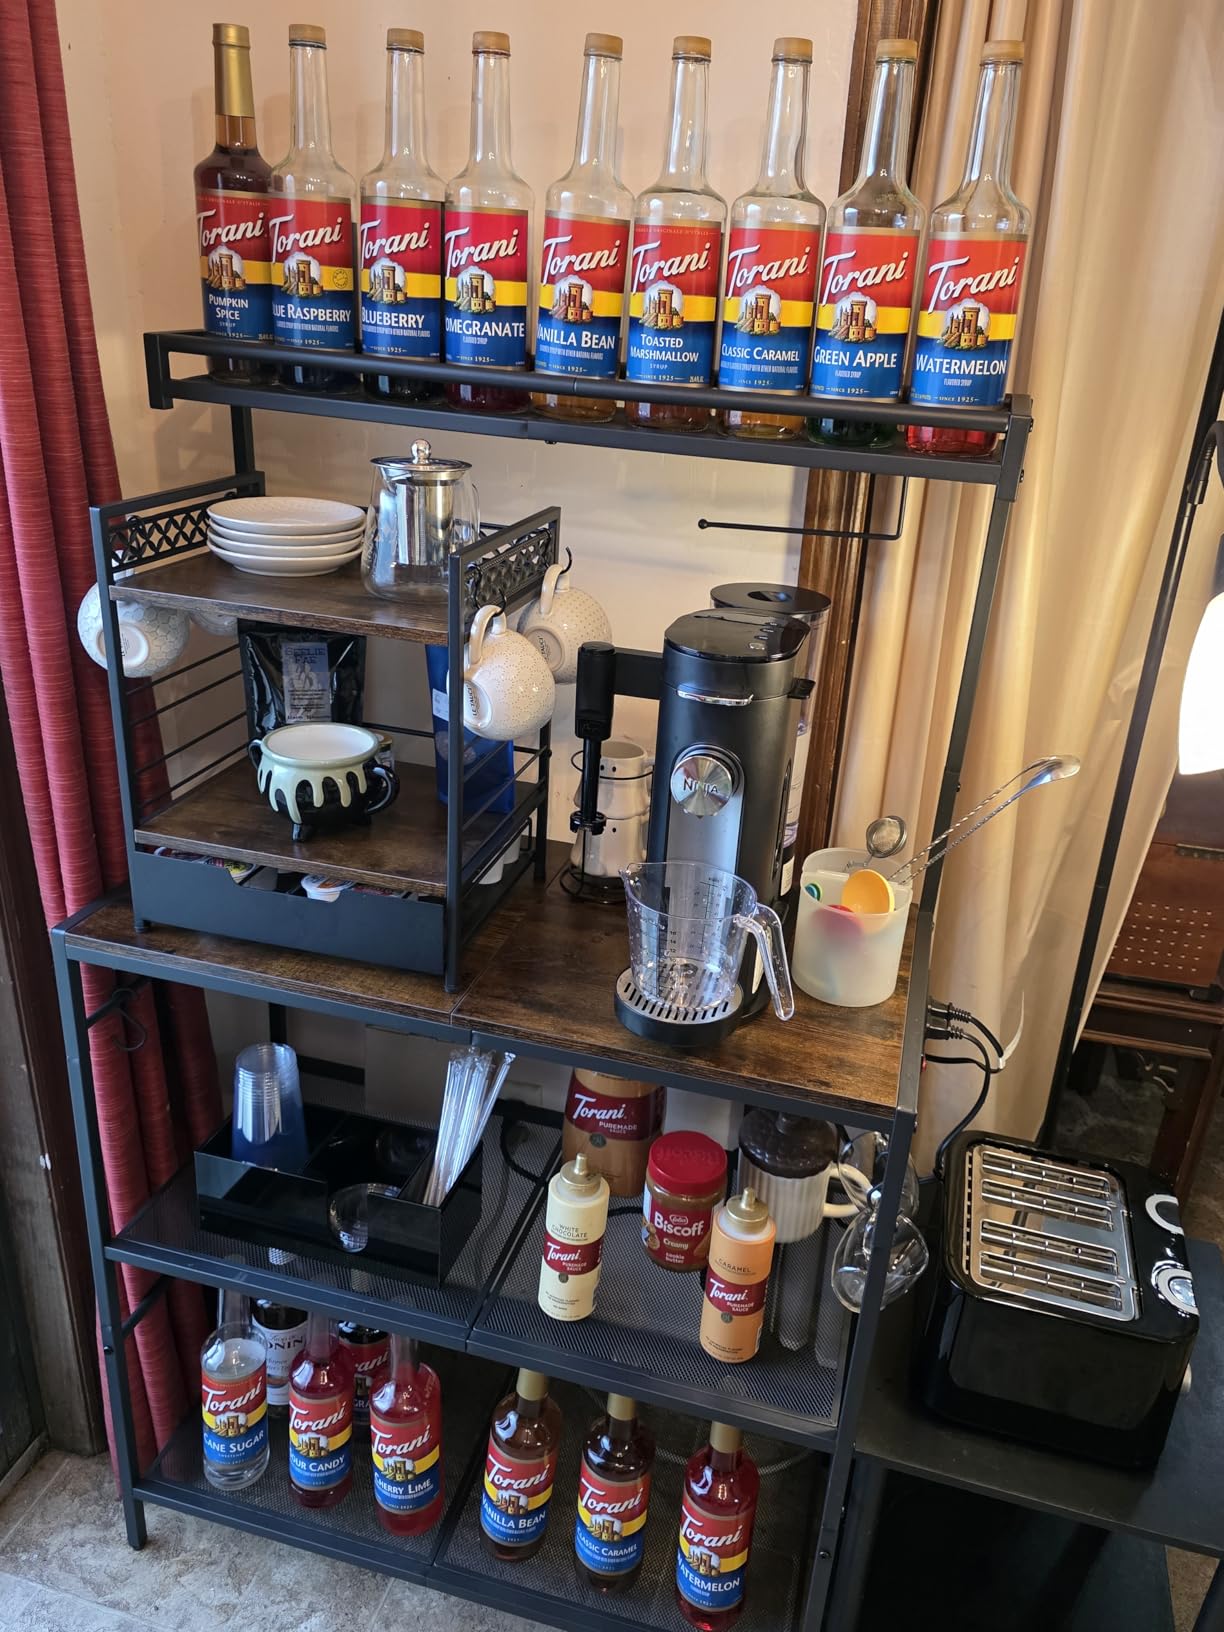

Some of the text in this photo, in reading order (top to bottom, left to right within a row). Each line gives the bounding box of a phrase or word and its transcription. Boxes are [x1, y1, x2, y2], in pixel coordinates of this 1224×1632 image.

[197, 208, 264, 247] Torani
[269, 213, 342, 264] Torani
[360, 219, 429, 269] Torani
[445, 227, 518, 280] Torani
[543, 235, 620, 287] Torani
[633, 240, 710, 295] Torani
[727, 244, 810, 300] Torani
[823, 249, 908, 306] Torani
[928, 256, 1019, 315] Torani
[208, 293, 249, 309] PUMPKIN
[287, 303, 351, 322] RASPBERRY
[215, 307, 240, 320] SPICE
[361, 306, 425, 329] BLUEBERRY
[446, 317, 525, 337] OMEGRANATE
[581, 331, 616, 349] BEAN
[641, 333, 684, 348] TOASTED
[630, 345, 699, 362] MARSHMALLOW
[721, 343, 800, 361] CLASSIC CARAMEL
[813, 345, 898, 368] GREEN APPLE
[567, 365, 583, 373] 1925
[916, 353, 1007, 375] WATERMELON
[847, 387, 864, 395] 1925
[683, 778, 719, 795] NIJA
[573, 1093, 626, 1119] Torani
[599, 1121, 637, 1131] PUREMADE
[551, 1224, 588, 1238] CHOCOLATE
[560, 1223, 581, 1232] WHITE
[654, 1210, 705, 1237] Biscoff
[547, 1241, 581, 1261] Torani
[663, 1238, 689, 1250] Creamy
[719, 1258, 752, 1273] CARAMEL
[709, 1278, 748, 1302] Torani
[202, 1376, 262, 1412] Torani
[289, 1400, 345, 1431] Torani
[204, 1430, 264, 1453] CANE SUGAR
[370, 1424, 430, 1455] Torani
[291, 1453, 345, 1472] OUR CANDY
[487, 1454, 550, 1490] Torani
[374, 1471, 431, 1495] CHERRY LIME
[581, 1477, 643, 1514] Torani
[518, 1510, 546, 1529] BEAN
[681, 1505, 742, 1547] Torani
[577, 1526, 637, 1557] CLASSIC CARAMEL
